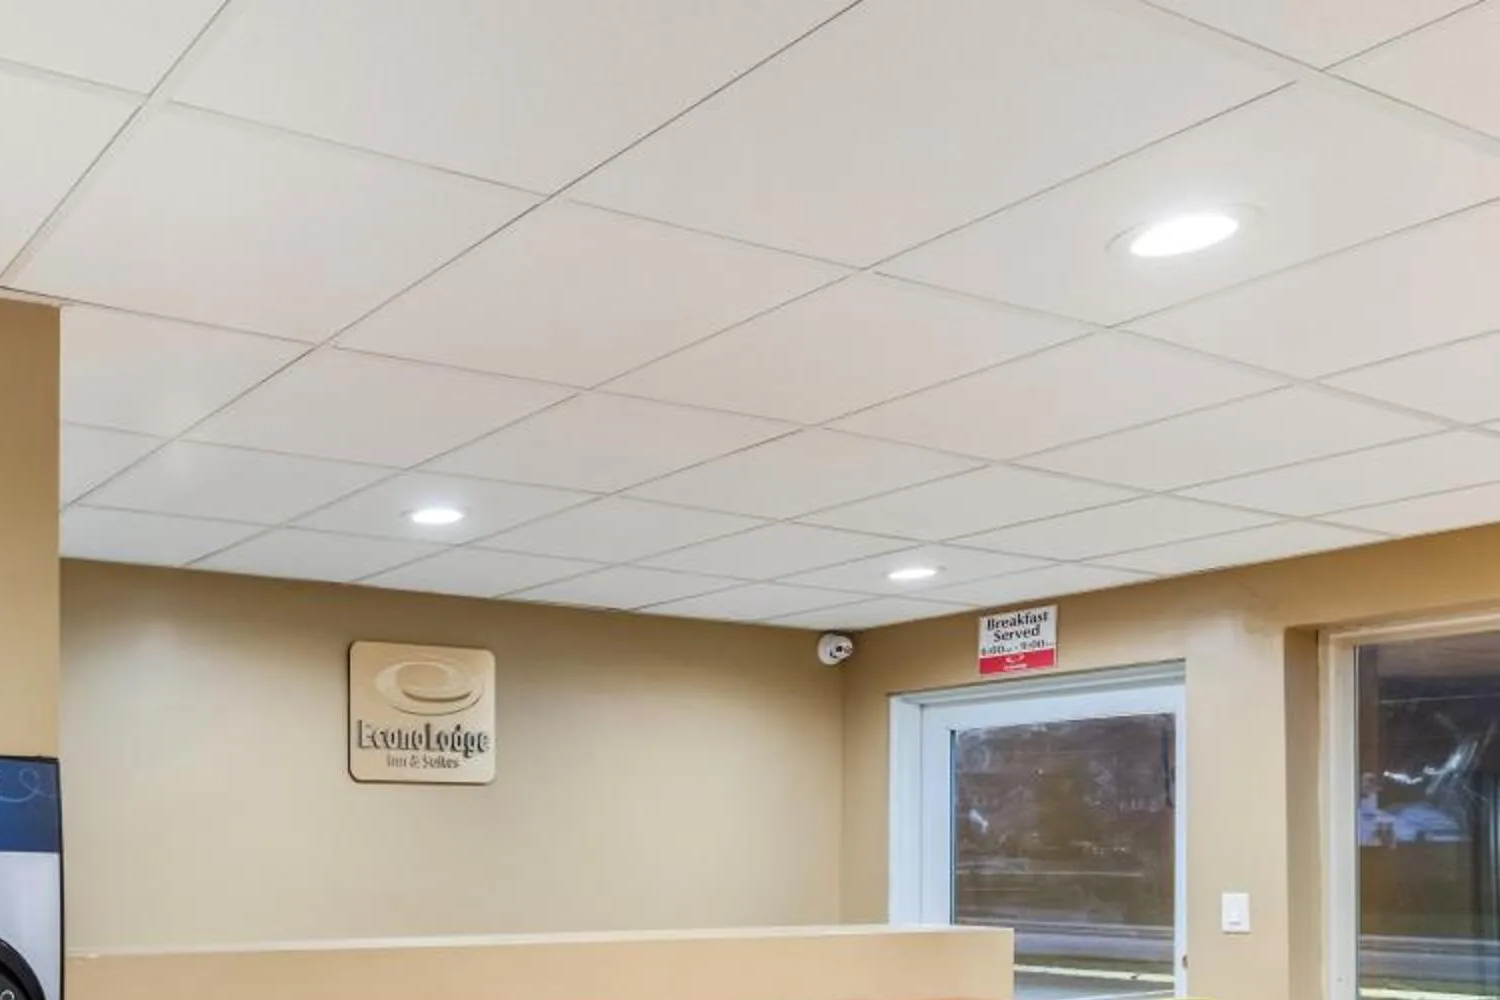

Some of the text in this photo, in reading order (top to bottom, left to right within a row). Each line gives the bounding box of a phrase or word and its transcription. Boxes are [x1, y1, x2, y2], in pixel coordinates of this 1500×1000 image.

[987, 611, 1049, 631] Breakfast
[993, 623, 1041, 643] Served
[387, 753, 460, 769] Inn & Suites
